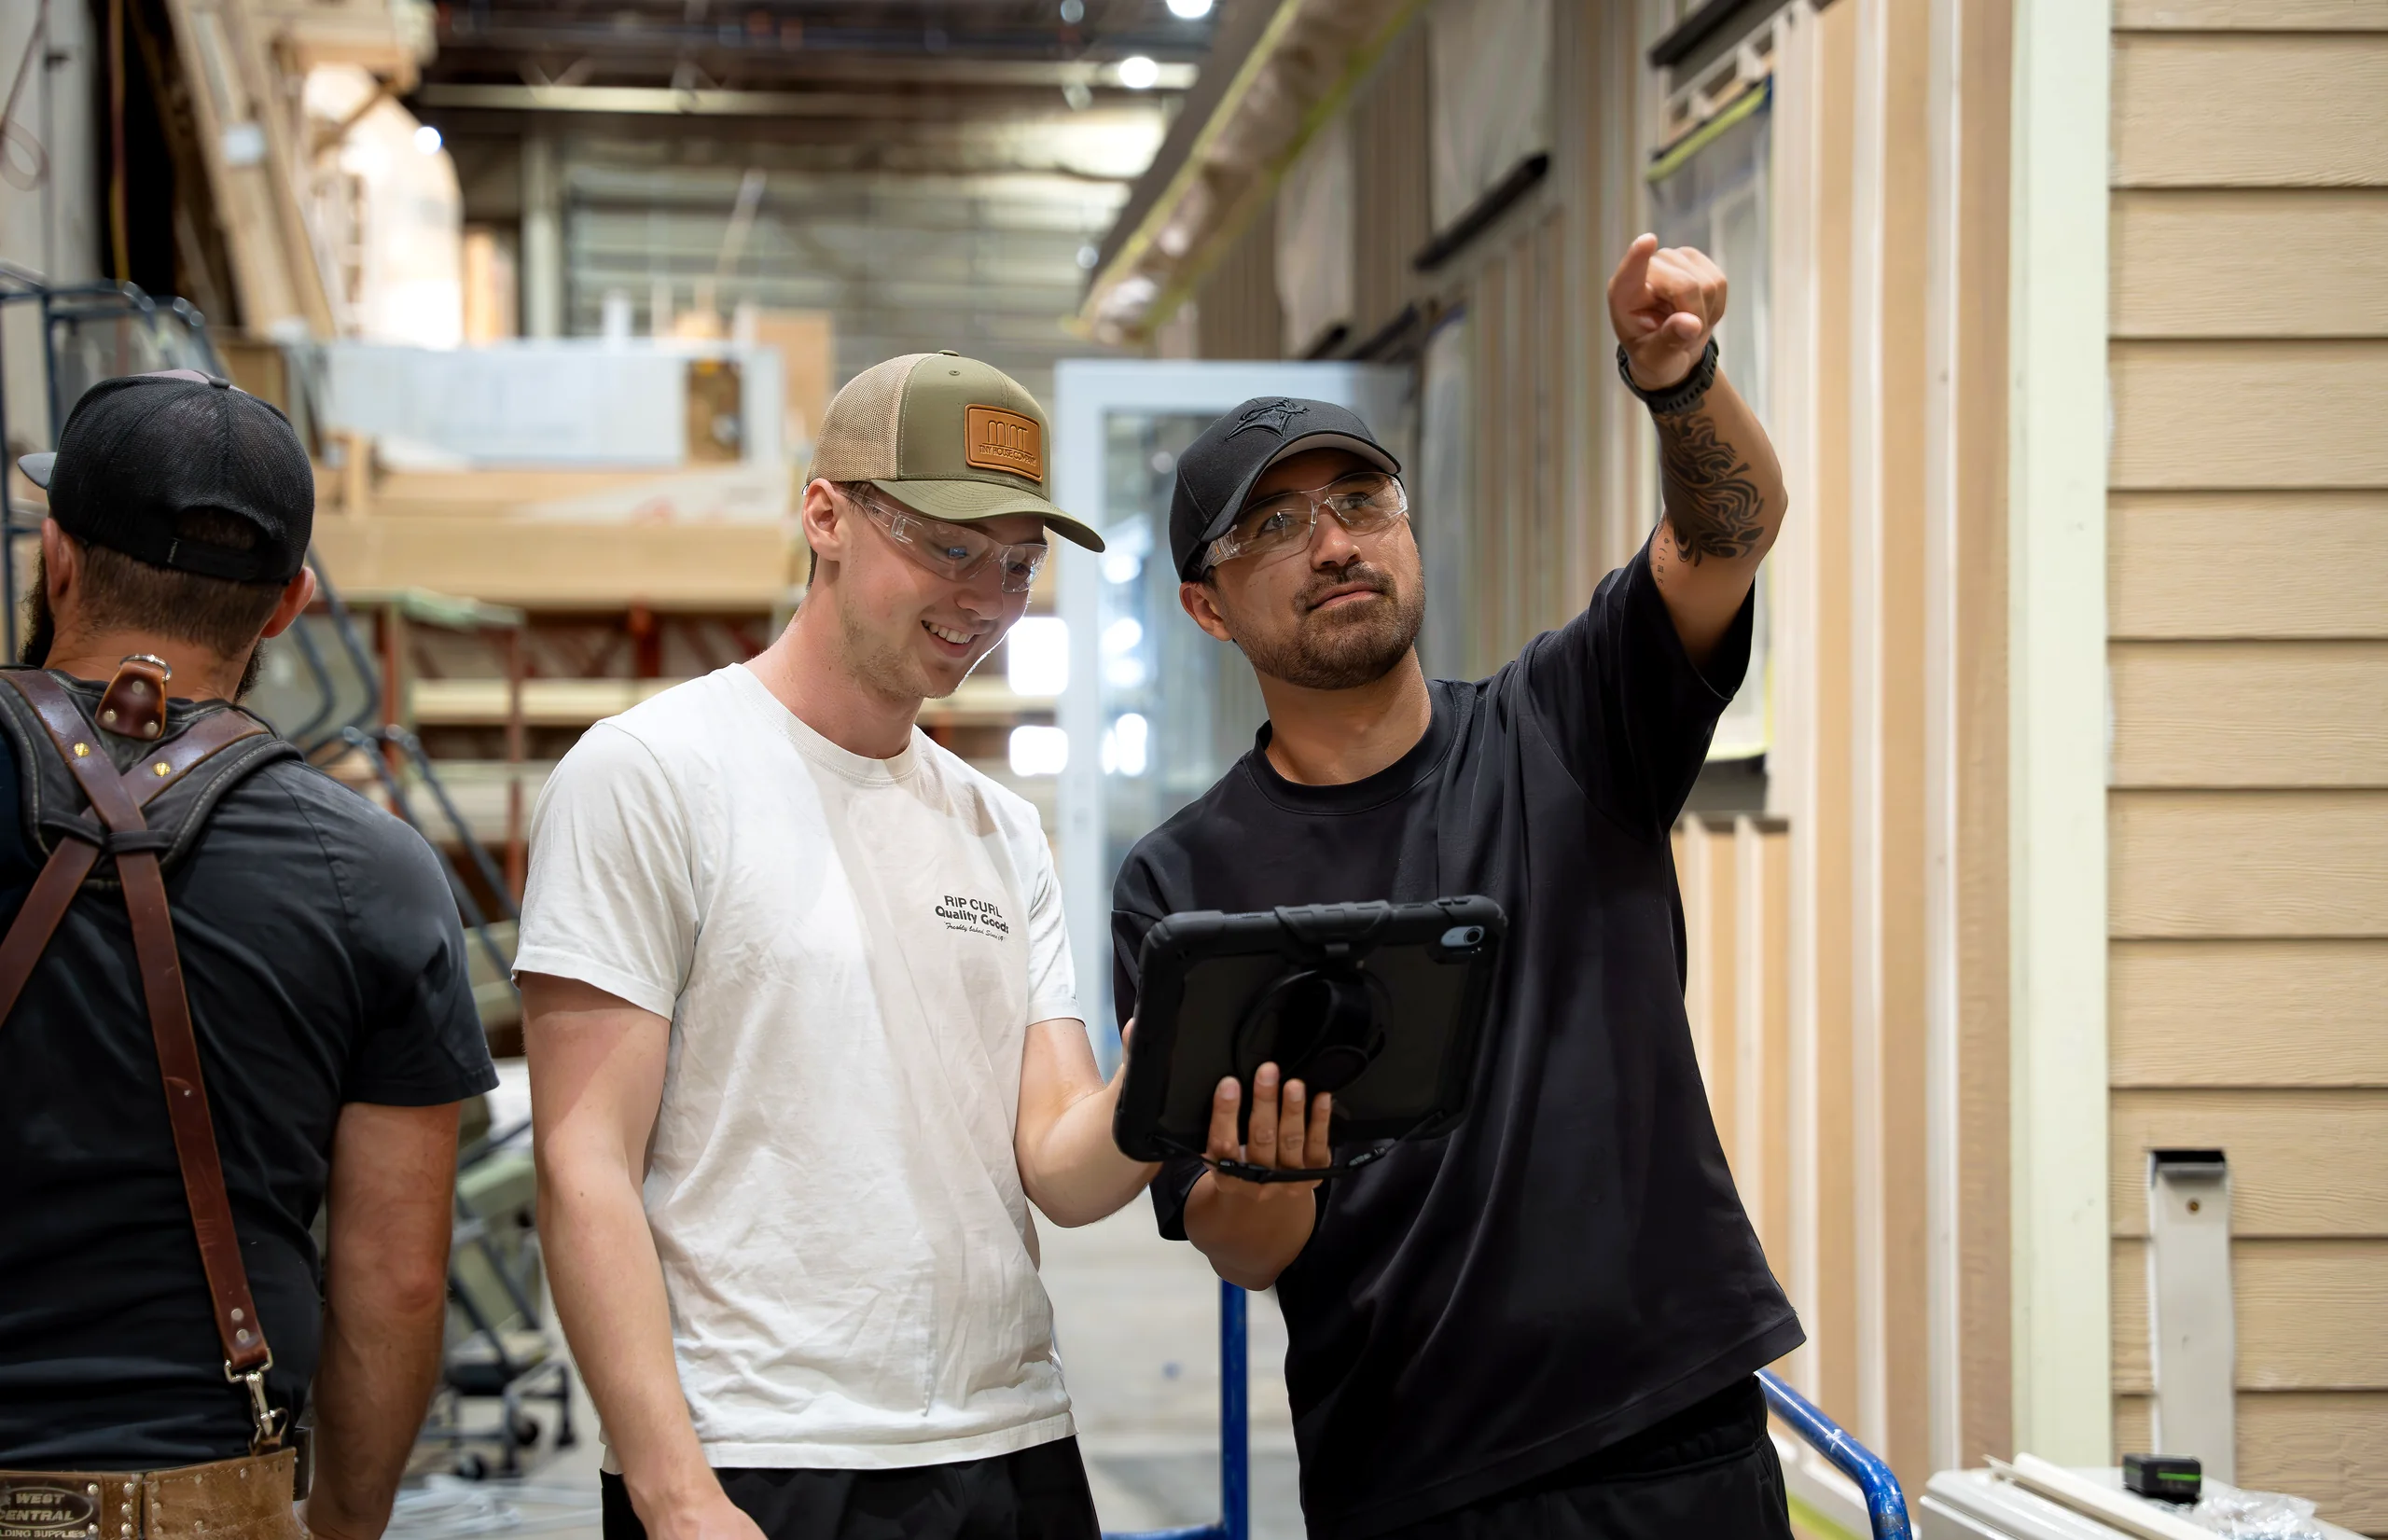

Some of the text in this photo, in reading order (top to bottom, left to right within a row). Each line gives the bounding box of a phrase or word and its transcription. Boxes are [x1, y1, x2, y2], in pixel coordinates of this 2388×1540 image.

[979, 444, 992, 455] TINY
[993, 447, 1014, 459] HOUSE
[944, 895, 1003, 919] RIP CURL
[935, 905, 1009, 935] Quality Goods
[16, 1493, 66, 1505] WEST
[34, 1530, 86, 1538] SUPPLIES
